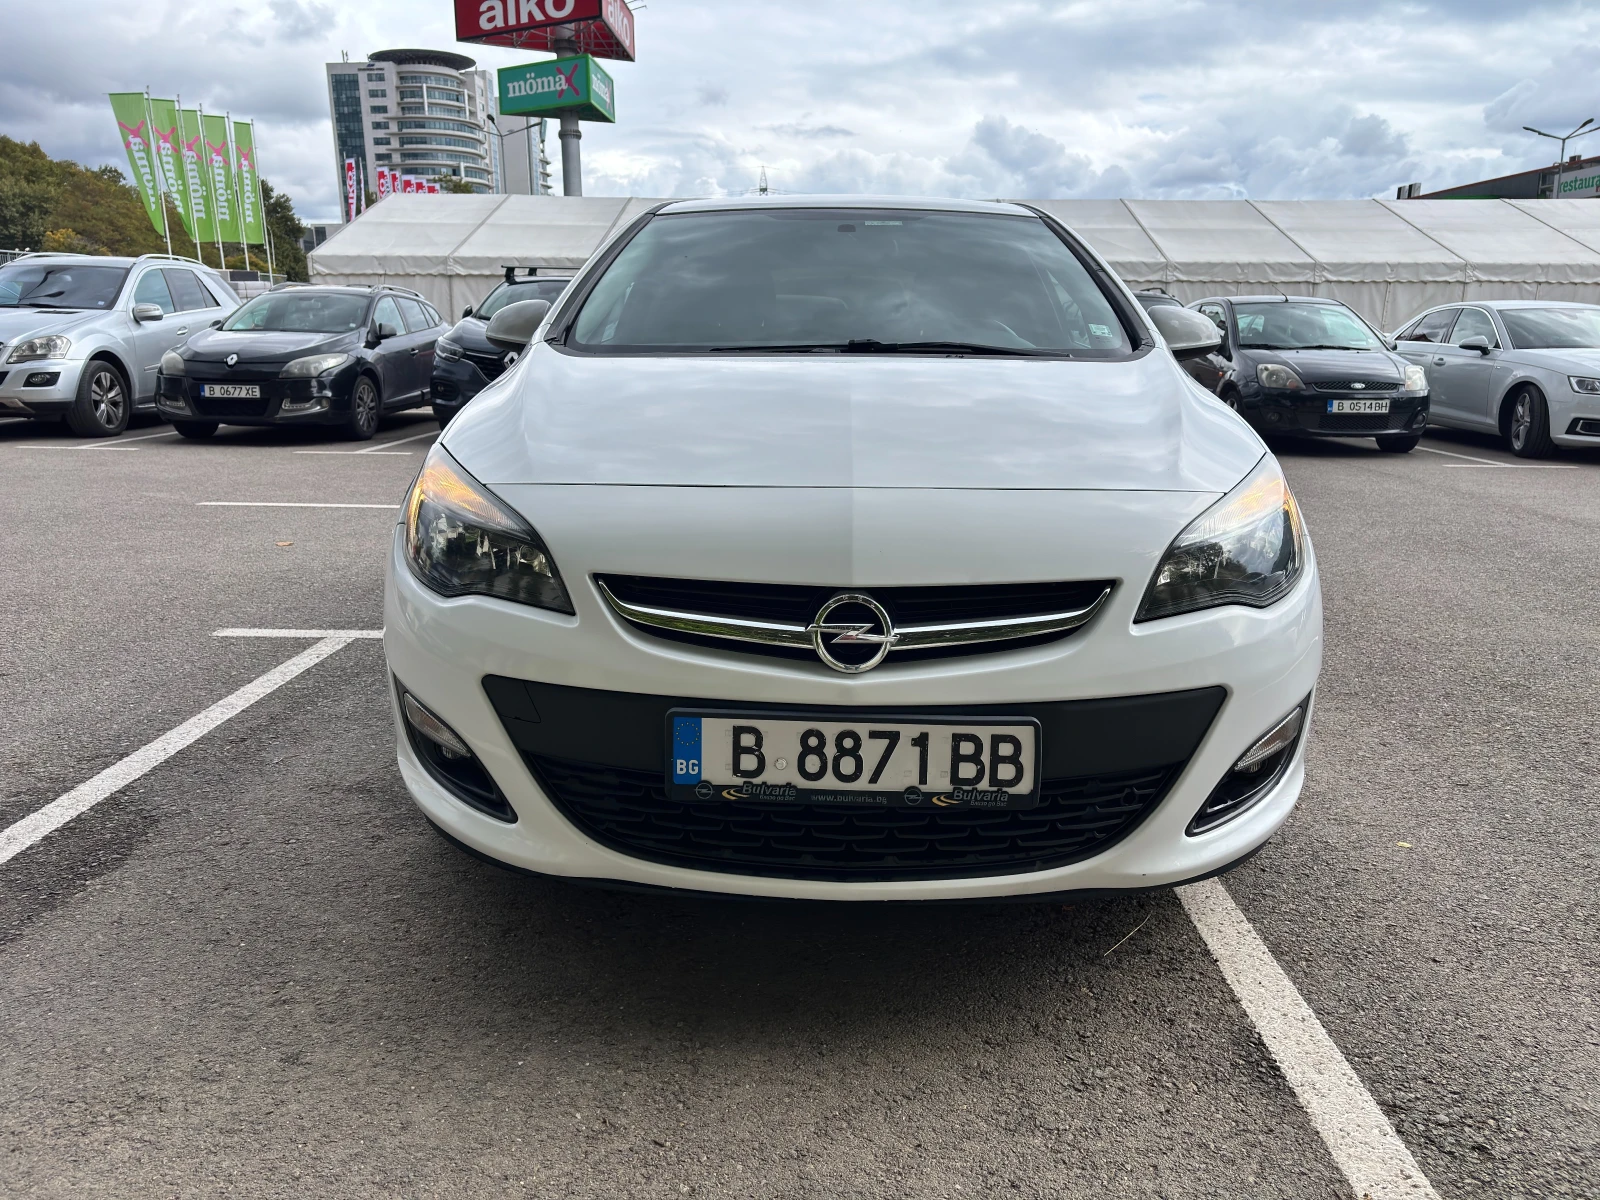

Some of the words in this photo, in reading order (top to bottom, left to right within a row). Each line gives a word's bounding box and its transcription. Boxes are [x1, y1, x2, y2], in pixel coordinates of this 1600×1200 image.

[208, 386, 215, 396] B
[219, 386, 243, 396] 0677
[245, 387, 258, 397] XE
[1337, 402, 1344, 411] B
[1349, 402, 1373, 411] 0514
[1374, 402, 1388, 411] BH
[732, 725, 766, 779] B
[797, 728, 929, 786] 8871
[950, 732, 1024, 788] BB
[676, 759, 699, 775] BG
[742, 783, 797, 796] Bulvaria
[953, 789, 1009, 802] Bulvaria
[811, 794, 888, 805] www.bulvaria.bg
